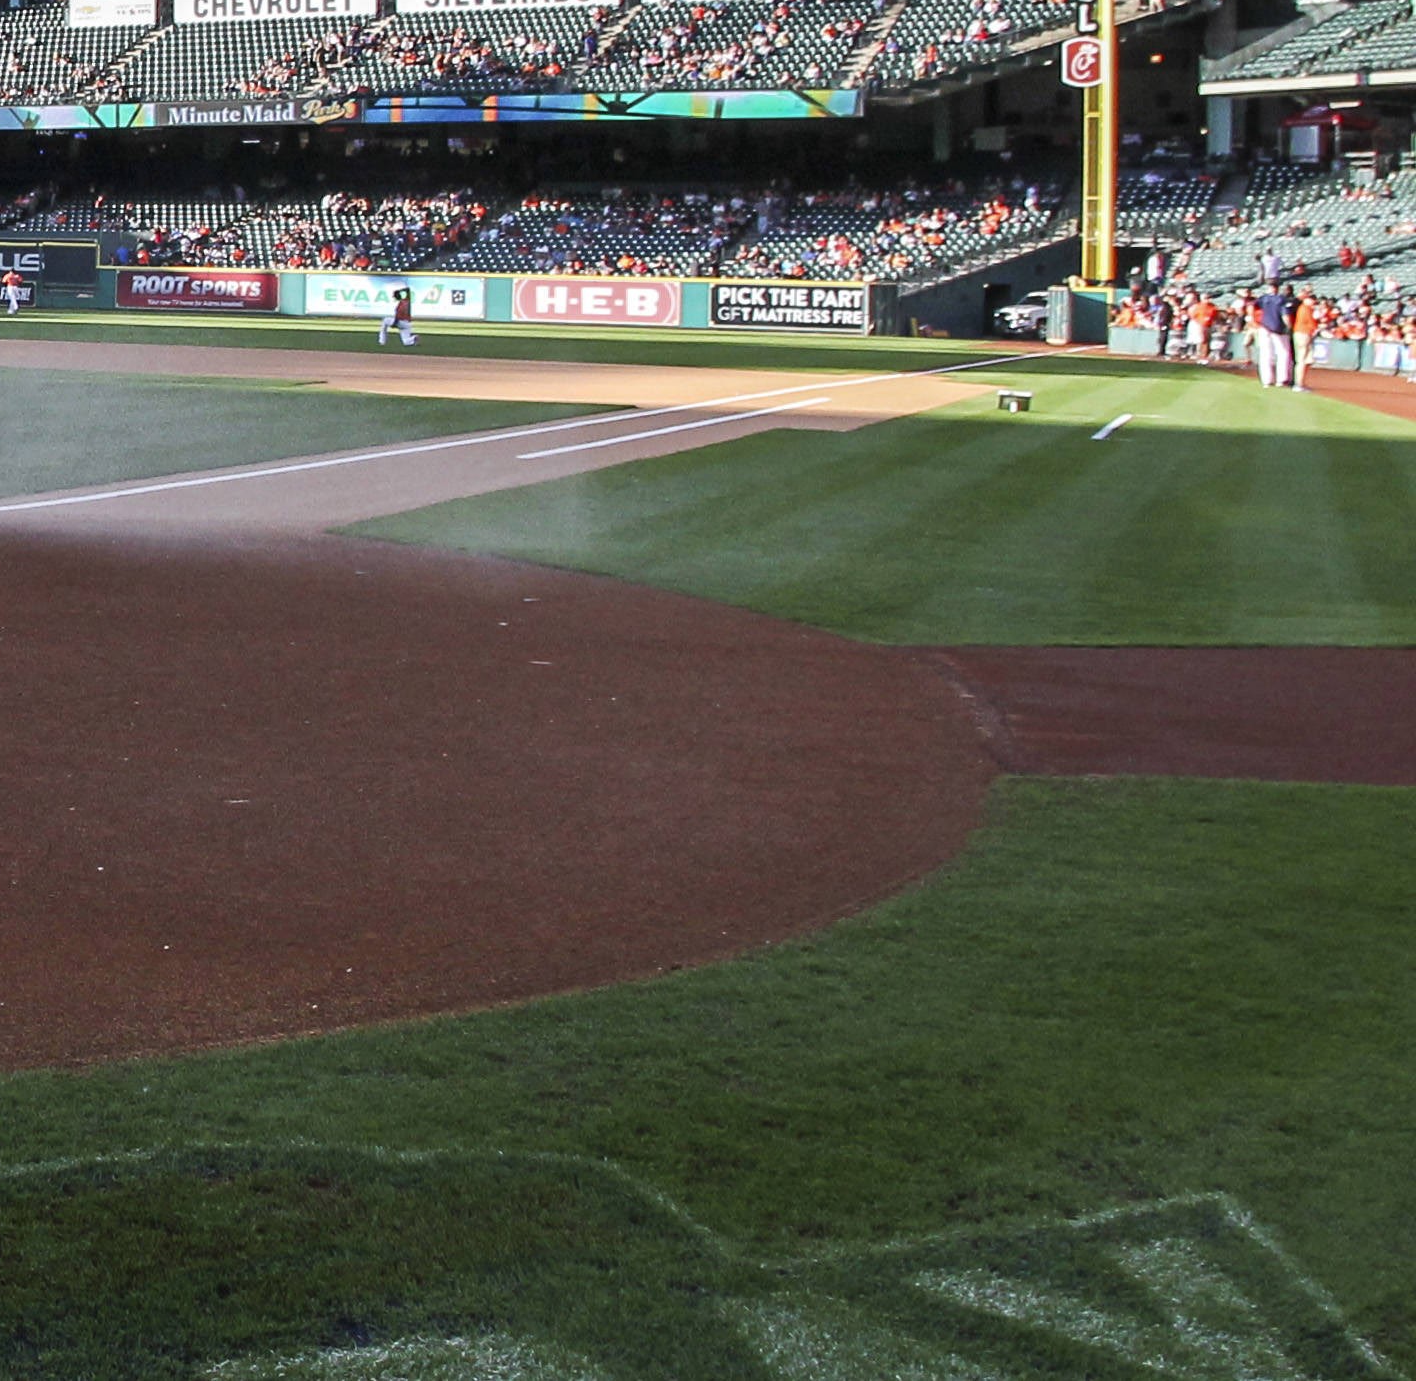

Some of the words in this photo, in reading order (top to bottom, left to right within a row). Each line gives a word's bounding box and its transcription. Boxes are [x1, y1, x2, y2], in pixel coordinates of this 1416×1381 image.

[169, 106, 241, 126] Minute
[242, 103, 296, 124] Maid
[131, 275, 189, 295] ROOT
[190, 281, 262, 297] SPORTS
[323, 287, 370, 303] EVA
[718, 286, 765, 307] PICK
[767, 288, 813, 308] THE
[817, 289, 863, 309] PART
[753, 308, 829, 324] MATTRESS
